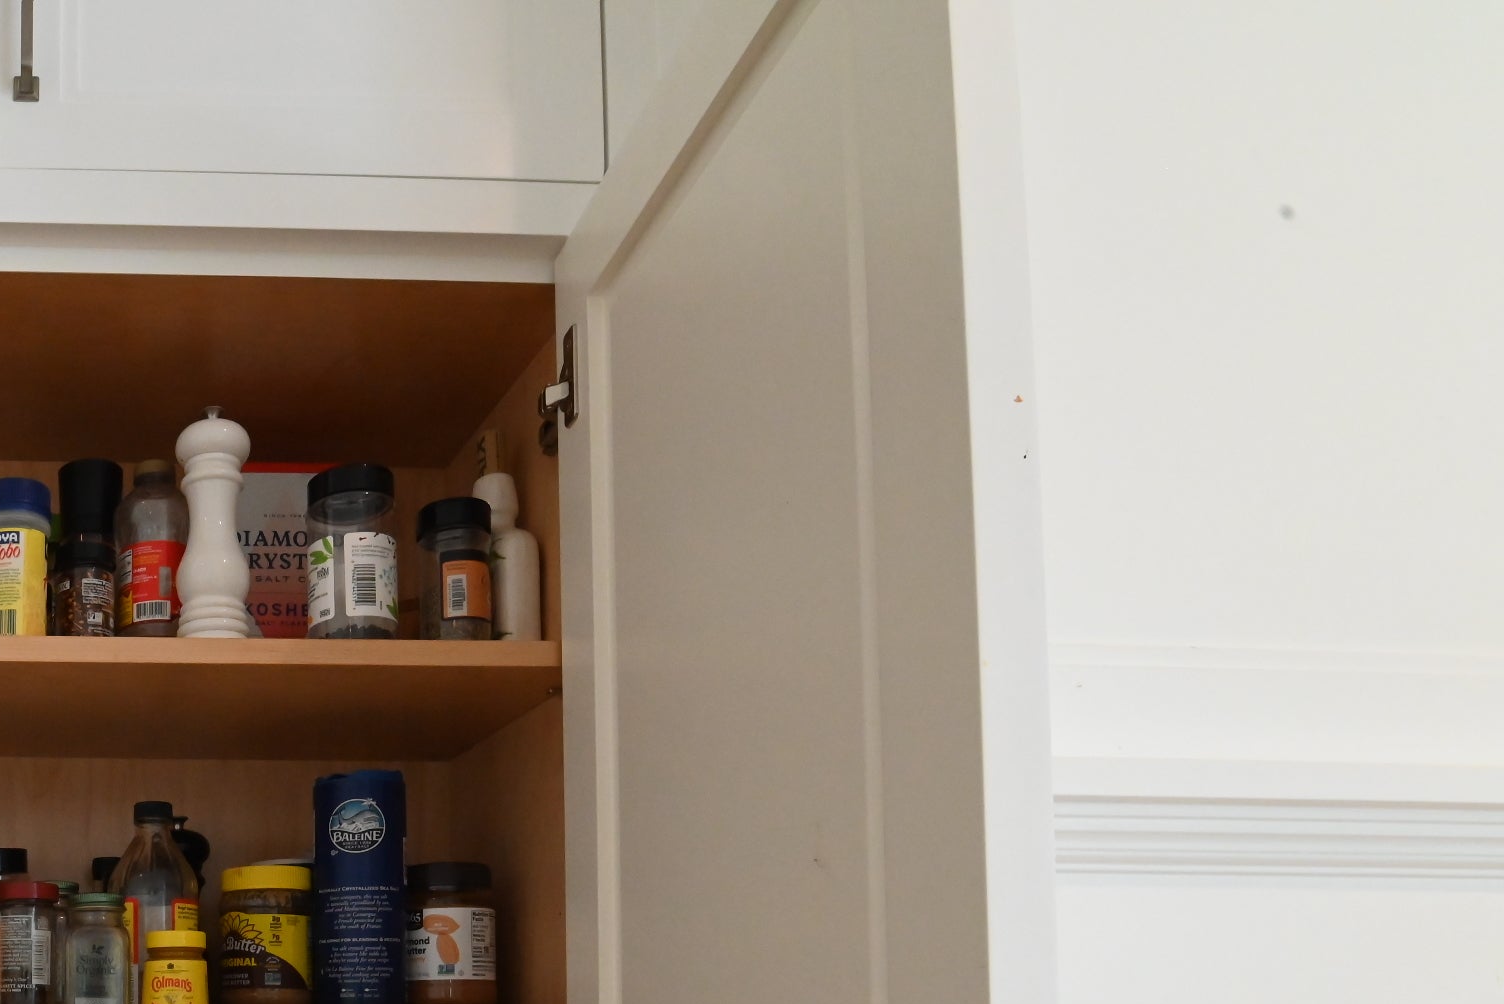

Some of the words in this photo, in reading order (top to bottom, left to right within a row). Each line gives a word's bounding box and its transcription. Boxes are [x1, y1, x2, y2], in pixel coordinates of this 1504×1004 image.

[236, 530, 308, 548] IAMO
[248, 552, 308, 570] RYST
[255, 575, 290, 583] SALT
[244, 602, 308, 617] KOSHE
[333, 830, 381, 842] BALEINE
[226, 936, 264, 954] Butter
[151, 975, 193, 993] Colman's
